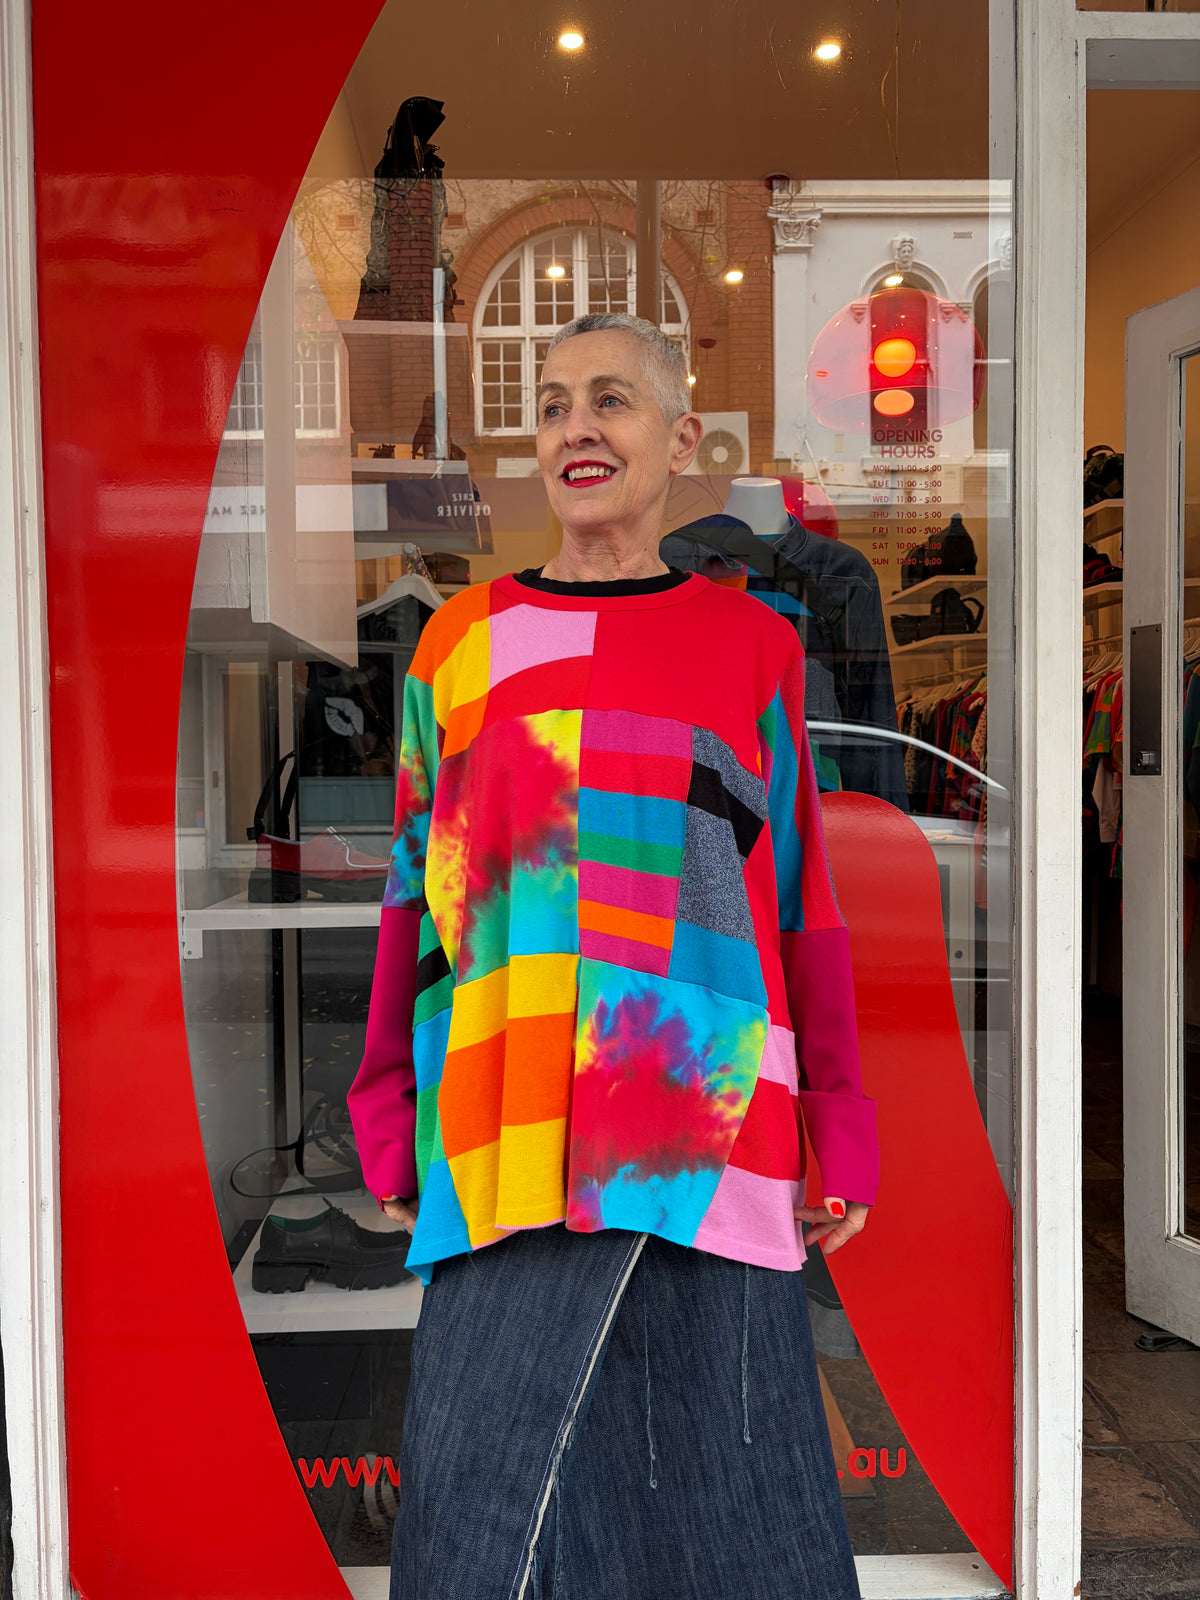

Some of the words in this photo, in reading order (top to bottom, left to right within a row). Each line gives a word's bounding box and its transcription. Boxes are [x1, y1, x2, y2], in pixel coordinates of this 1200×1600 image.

[873, 429, 943, 443] OPENING
[880, 445, 936, 459] HOURS
[872, 480, 890, 488] TUE
[896, 480, 917, 488] 11:00
[924, 480, 942, 488] 5:00
[924, 496, 942, 504] 5:00
[872, 511, 889, 519] THU
[896, 511, 917, 519] 11:00
[924, 511, 942, 519] 5:00
[872, 542, 889, 550] SAT
[896, 542, 917, 550] 10:00
